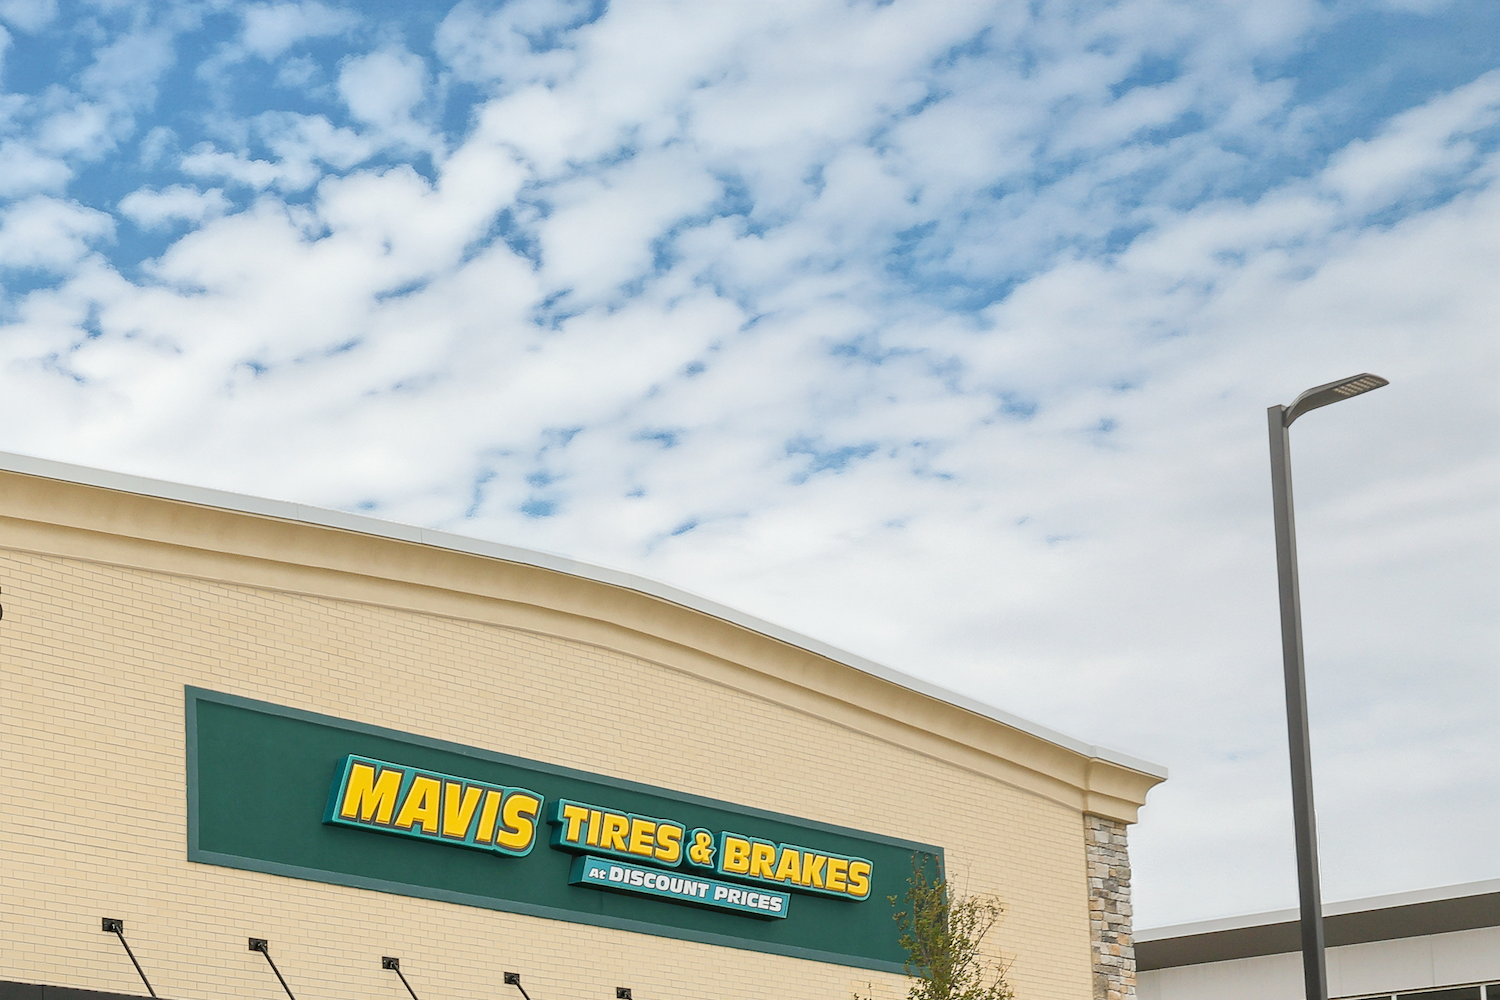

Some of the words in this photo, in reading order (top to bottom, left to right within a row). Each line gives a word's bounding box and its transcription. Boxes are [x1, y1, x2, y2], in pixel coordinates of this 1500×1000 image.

[340, 763, 538, 850] MAVIS
[563, 804, 683, 862] TIRES
[689, 829, 715, 867] &
[723, 837, 872, 897] BRAKES
[609, 867, 710, 899] DISCOUNT
[713, 886, 783, 913] PRICES
